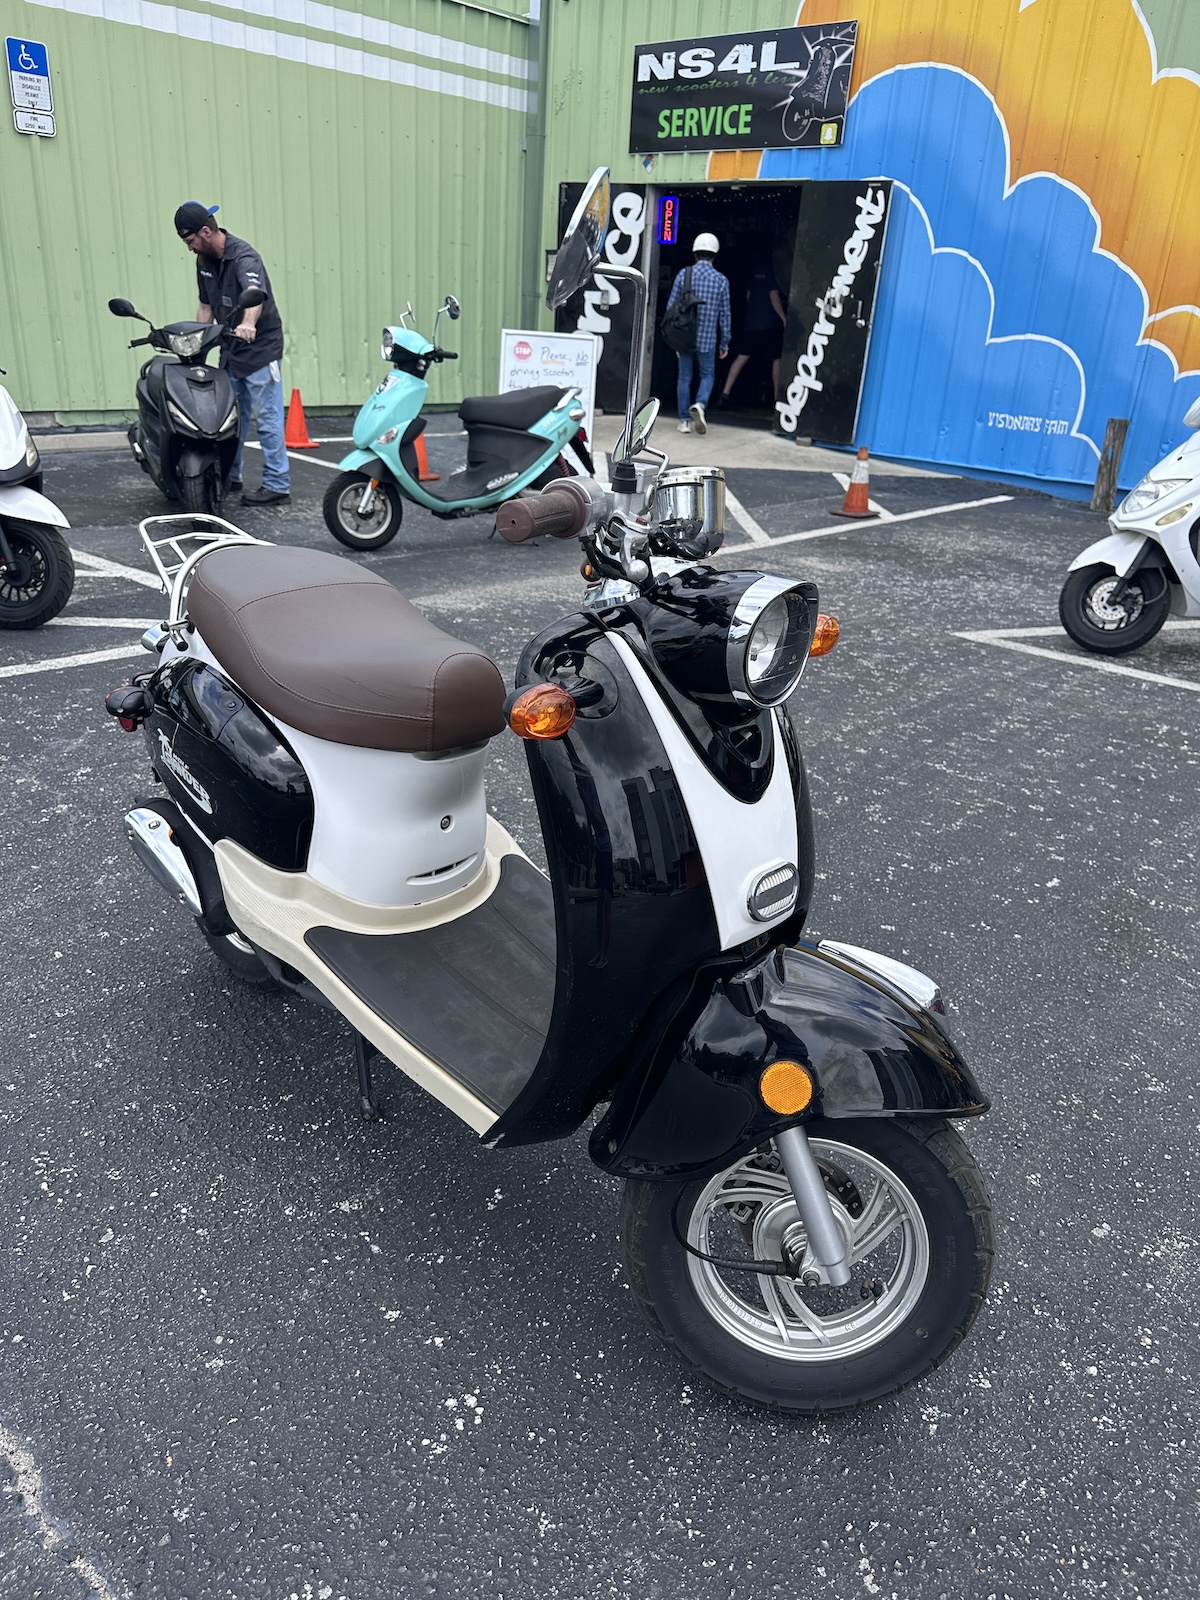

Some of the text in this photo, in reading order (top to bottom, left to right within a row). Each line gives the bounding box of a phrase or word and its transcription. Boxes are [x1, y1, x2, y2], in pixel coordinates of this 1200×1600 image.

[637, 41, 800, 82] NS4L
[637, 72, 798, 95] new scooters 4 less
[657, 103, 753, 139] SERVICE
[663, 199, 674, 242] OPEN
[775, 187, 886, 433] department
[514, 347, 532, 355] STOP
[576, 350, 589, 361] No
[510, 365, 540, 380] driving
